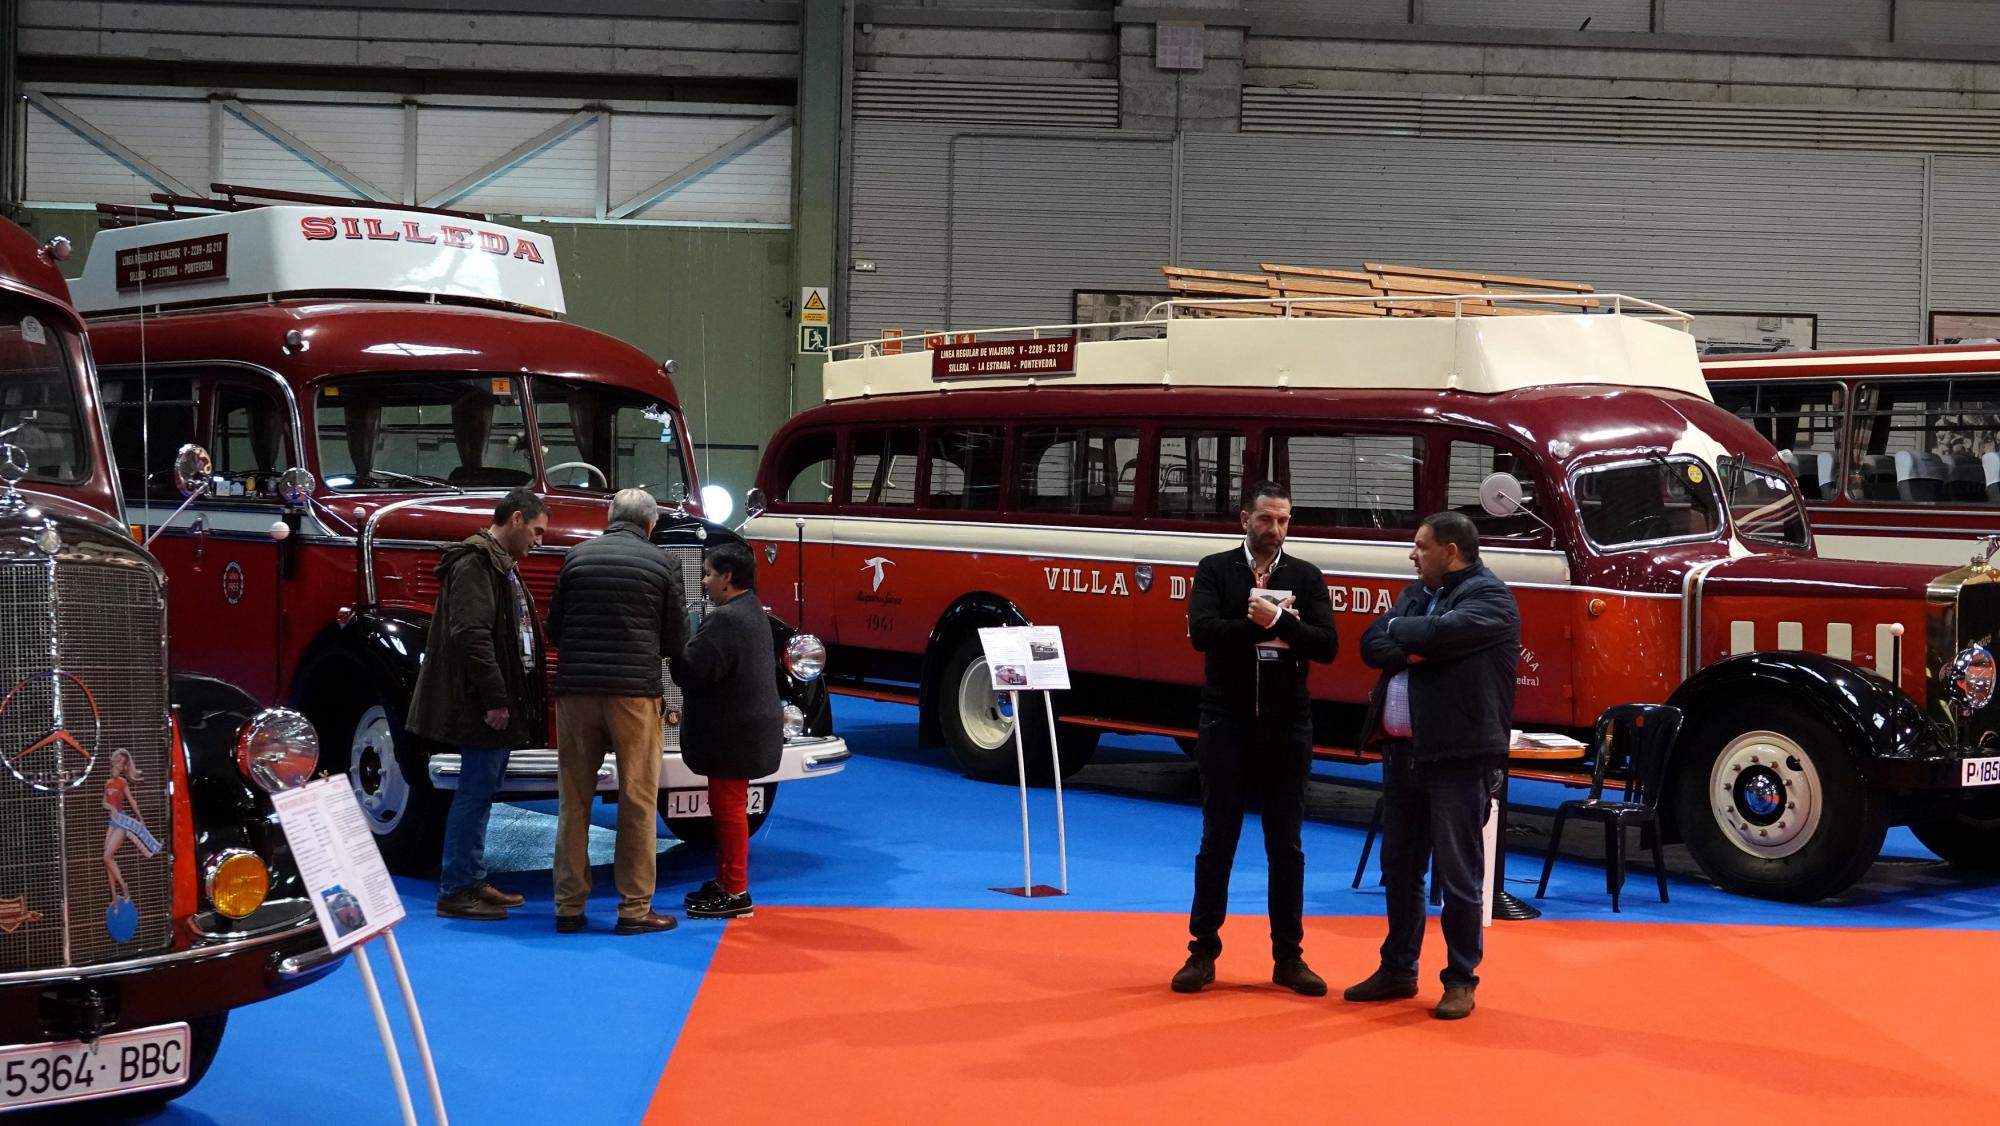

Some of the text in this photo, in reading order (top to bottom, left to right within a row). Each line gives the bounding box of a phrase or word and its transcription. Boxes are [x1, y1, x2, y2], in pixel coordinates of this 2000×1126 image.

[300, 216, 544, 264] SILLEDA
[184, 260, 213, 274] PONTEVEDRA
[941, 350, 955, 359] LINEA
[956, 348, 979, 358] REGULAR
[980, 347, 987, 357] DE
[988, 346, 1015, 356] VIAJEROS
[1057, 343, 1068, 353] 210
[949, 362, 969, 372] SILLEDA
[978, 361, 986, 371] LA
[986, 360, 1011, 371] ESTRADA
[1020, 358, 1057, 369] PONTEVEDRA
[1044, 567, 1393, 613] VILLA D EDA
[866, 614, 894, 632] 1941
[1520, 644, 1540, 672] IÑA
[1516, 675, 1540, 687] edra)
[751, 791, 760, 809] 2
[120, 1040, 181, 1082] BBC
